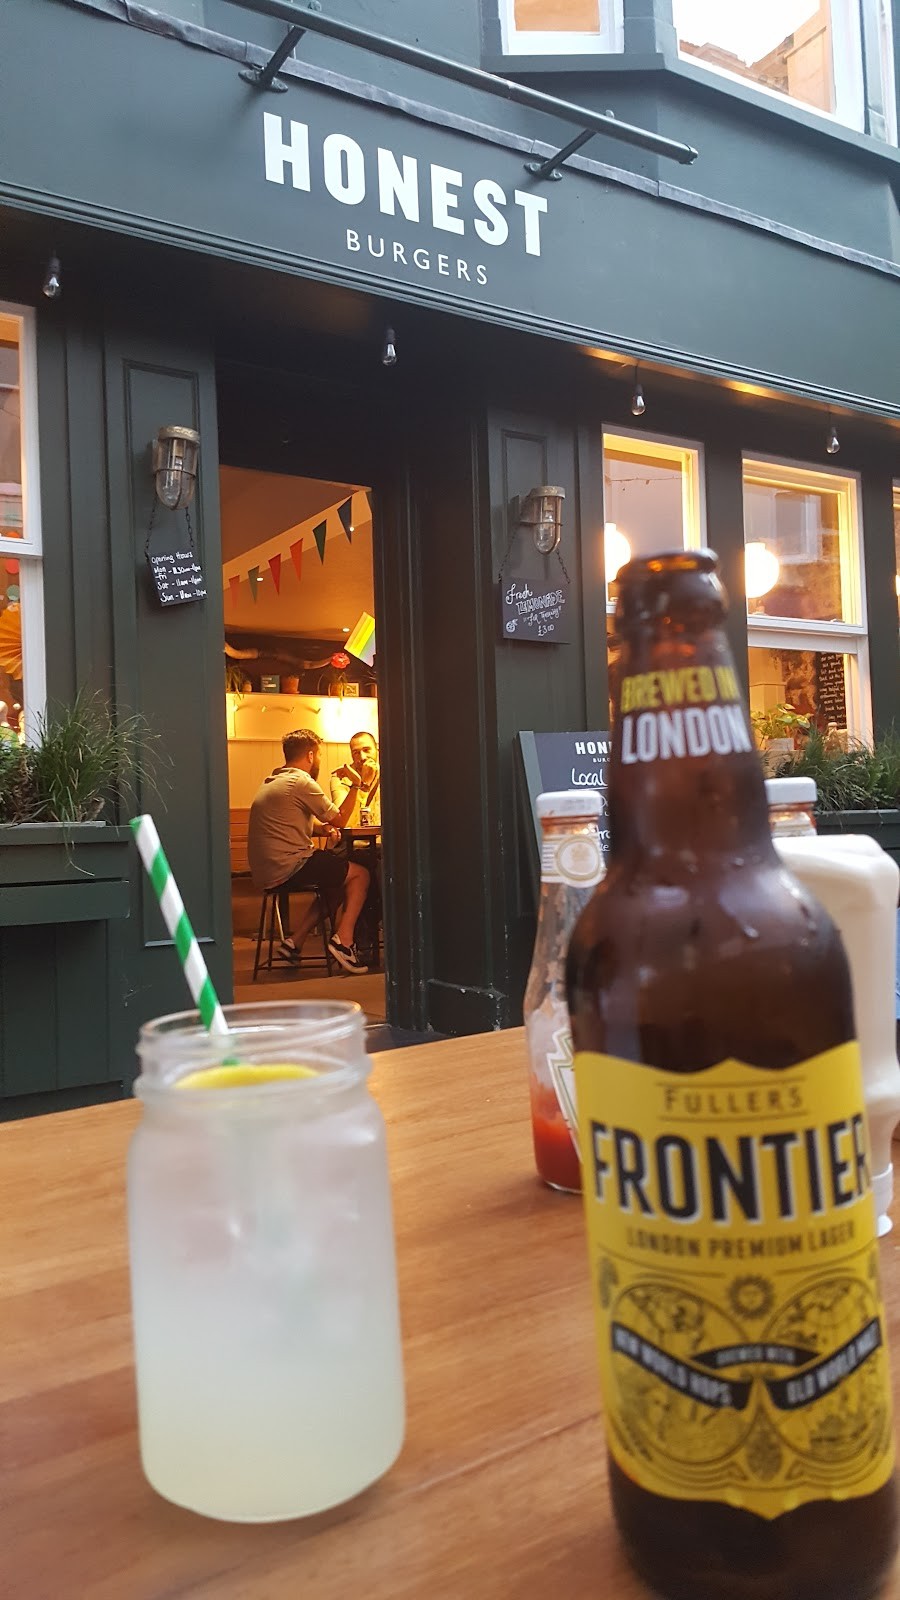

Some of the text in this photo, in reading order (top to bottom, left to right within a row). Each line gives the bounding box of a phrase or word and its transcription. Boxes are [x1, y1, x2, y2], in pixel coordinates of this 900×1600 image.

[263, 111, 548, 257] HONEST
[346, 229, 489, 285] BURGERS
[160, 592, 175, 603] Sun
[621, 703, 752, 765] LONDON
[590, 1113, 872, 1228] FRONTIER
[626, 1219, 855, 1259] LONDON PREMIUM LAGER
